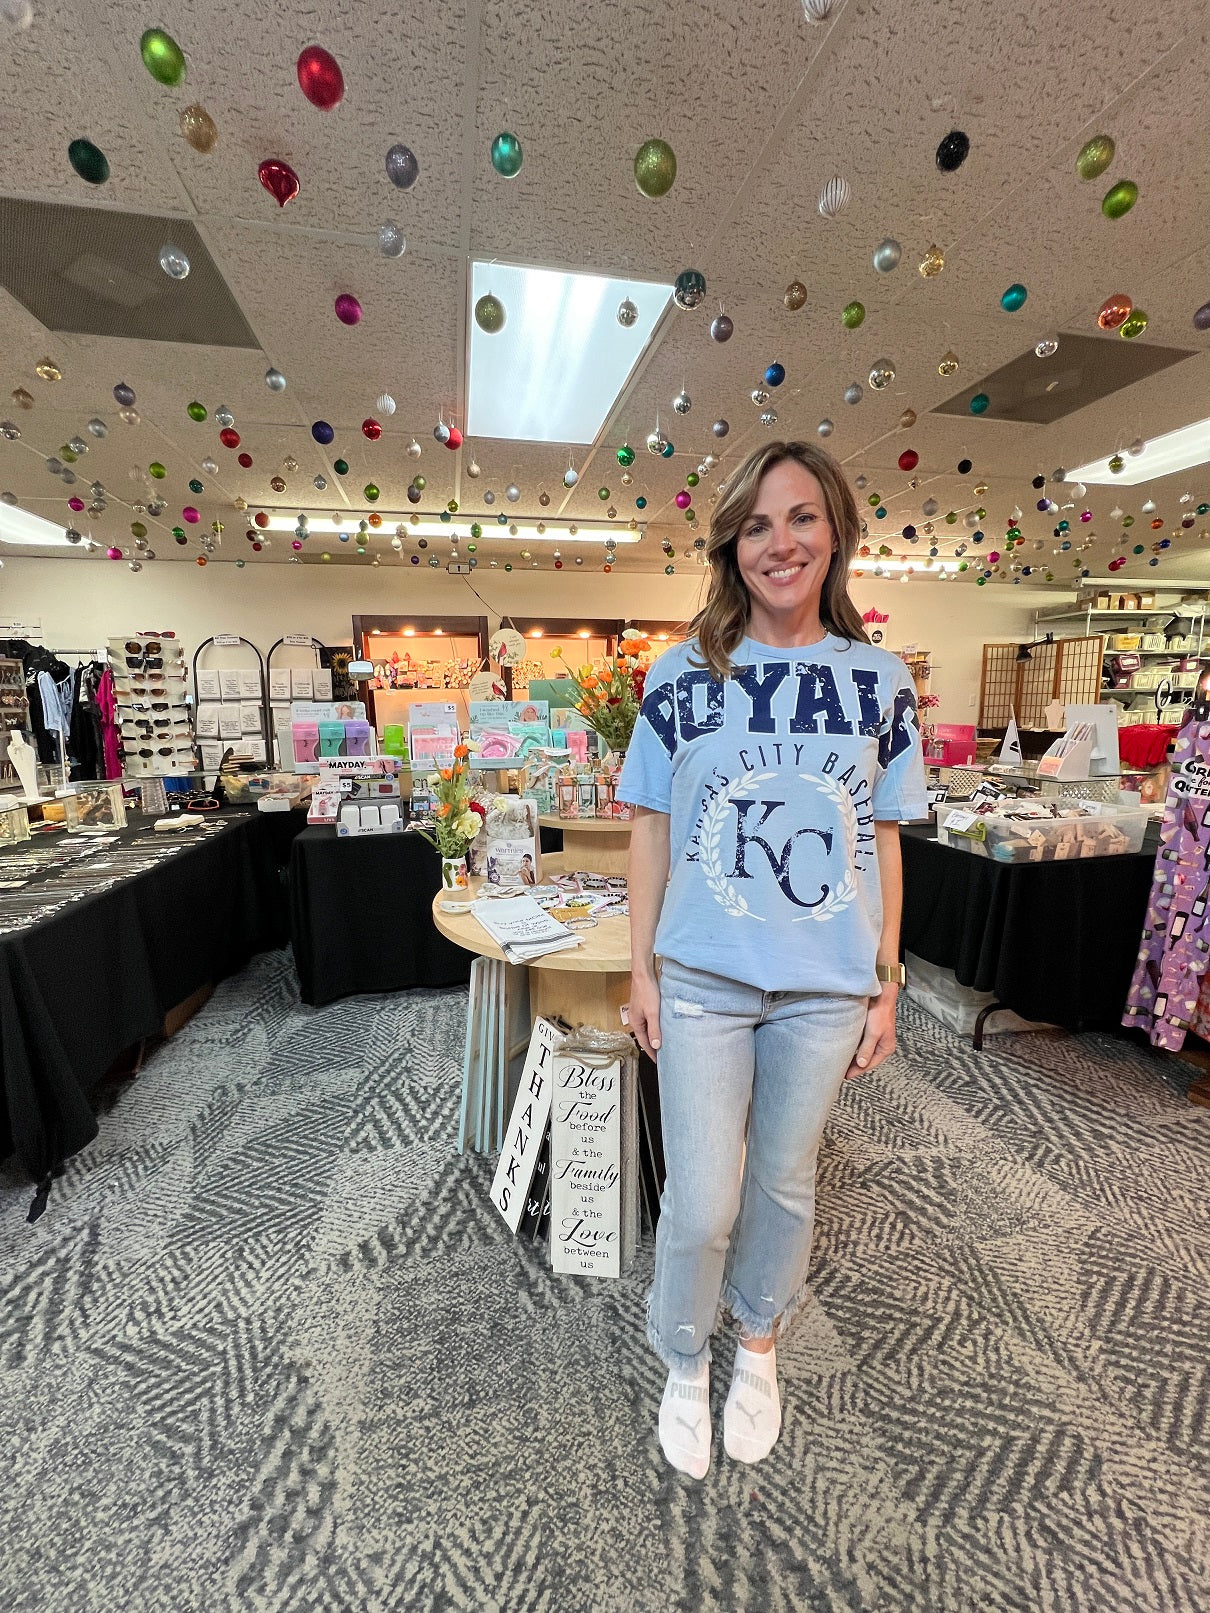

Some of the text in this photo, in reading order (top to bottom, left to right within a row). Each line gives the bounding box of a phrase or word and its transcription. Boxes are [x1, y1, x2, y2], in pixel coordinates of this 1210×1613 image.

[686, 767, 730, 863] KANSAS
[739, 743, 804, 772] CITY
[725, 799, 834, 908] KC
[538, 1023, 555, 1042] GIV
[558, 1064, 617, 1092] Bless
[579, 1090, 597, 1100] the
[556, 1100, 618, 1124] Food
[499, 1042, 551, 1212] THANKS
[569, 1121, 607, 1133] before
[581, 1136, 594, 1144] us
[571, 1148, 603, 1158] & the
[555, 1159, 620, 1188] Family
[570, 1181, 606, 1192] beside
[581, 1195, 594, 1204] us
[571, 1208, 603, 1219] & the
[558, 1217, 618, 1247] Love
[564, 1246, 610, 1259] between
[580, 1260, 594, 1269] us
[670, 1382, 709, 1403] PUMA
[734, 1368, 772, 1400] PUMA
